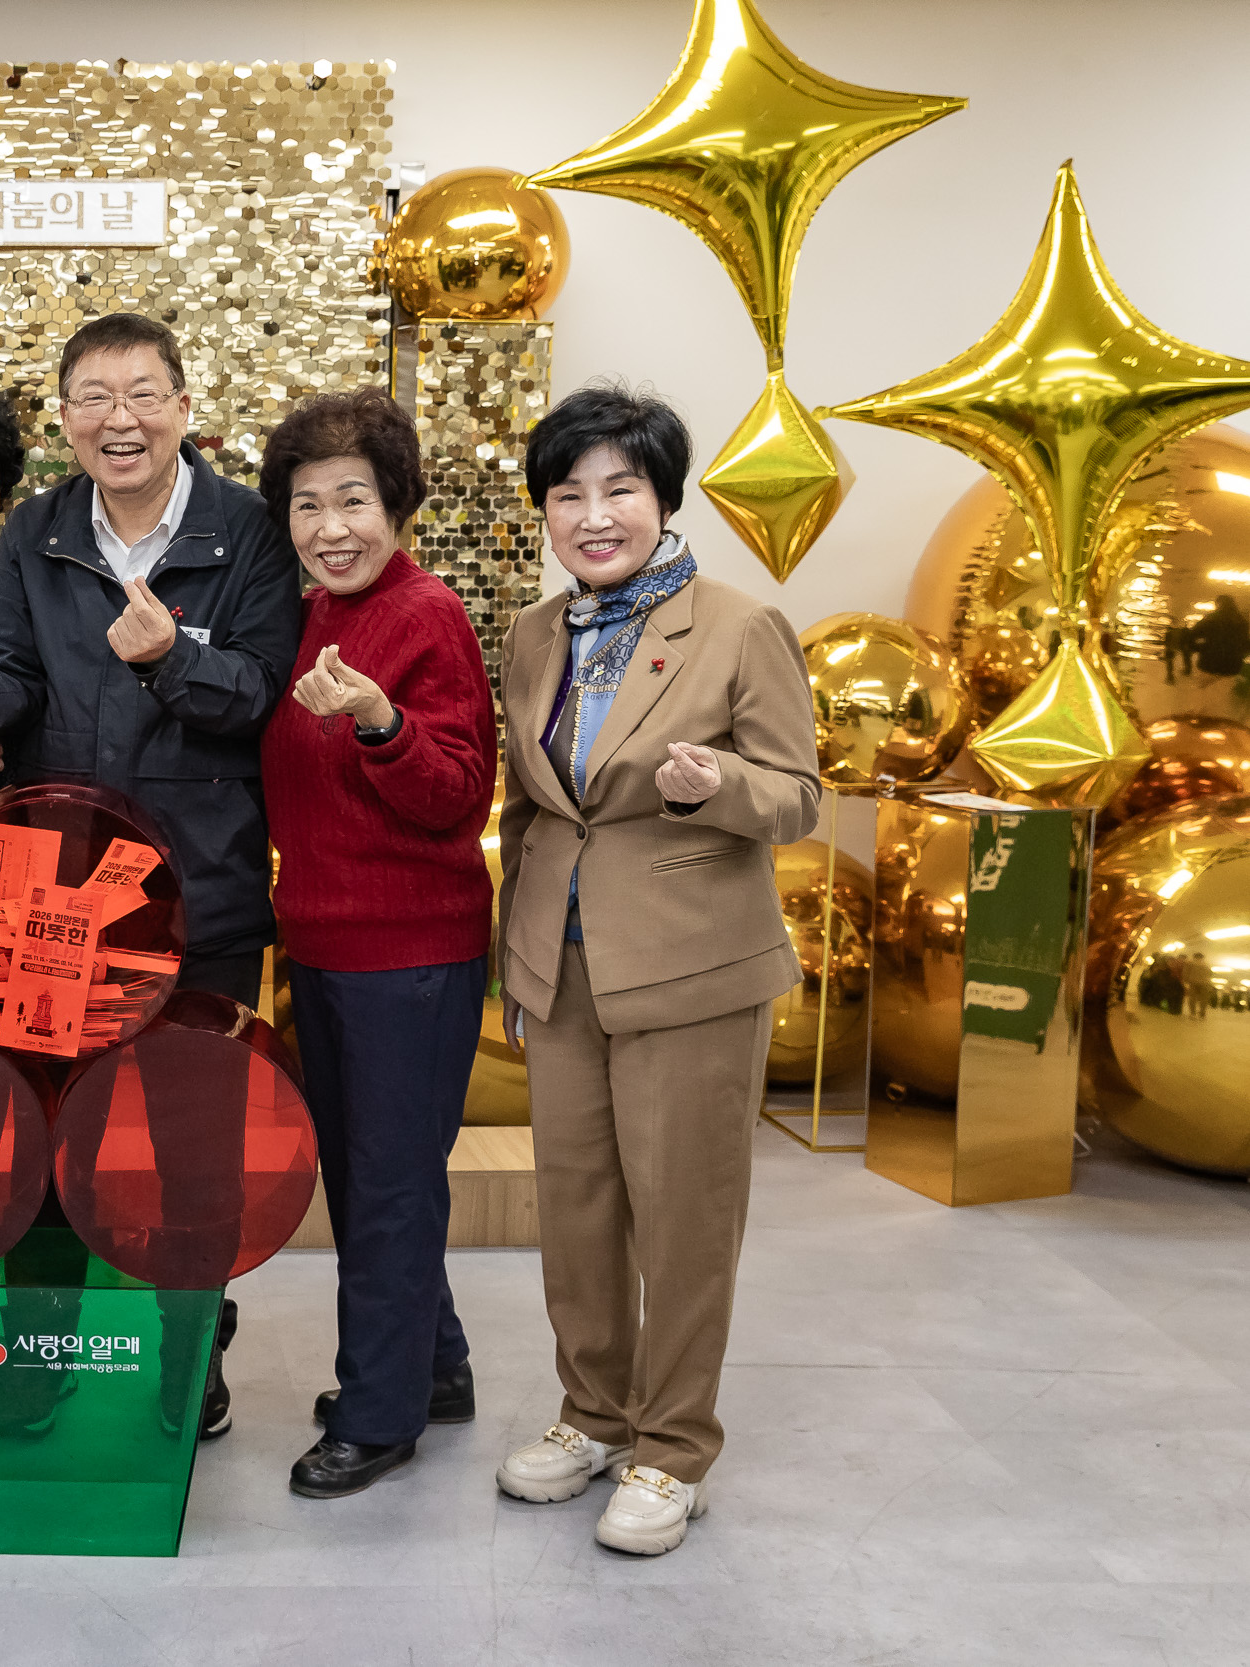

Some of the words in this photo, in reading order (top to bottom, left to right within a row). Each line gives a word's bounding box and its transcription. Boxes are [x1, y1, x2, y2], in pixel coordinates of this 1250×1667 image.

[99, 190, 138, 230] 날
[29, 909, 52, 921] 2026
[25, 920, 89, 947] 따뜻한
[12, 1334, 83, 1360] 사랑의
[88, 1335, 140, 1360] 열매
[45, 1362, 62, 1371] 서울
